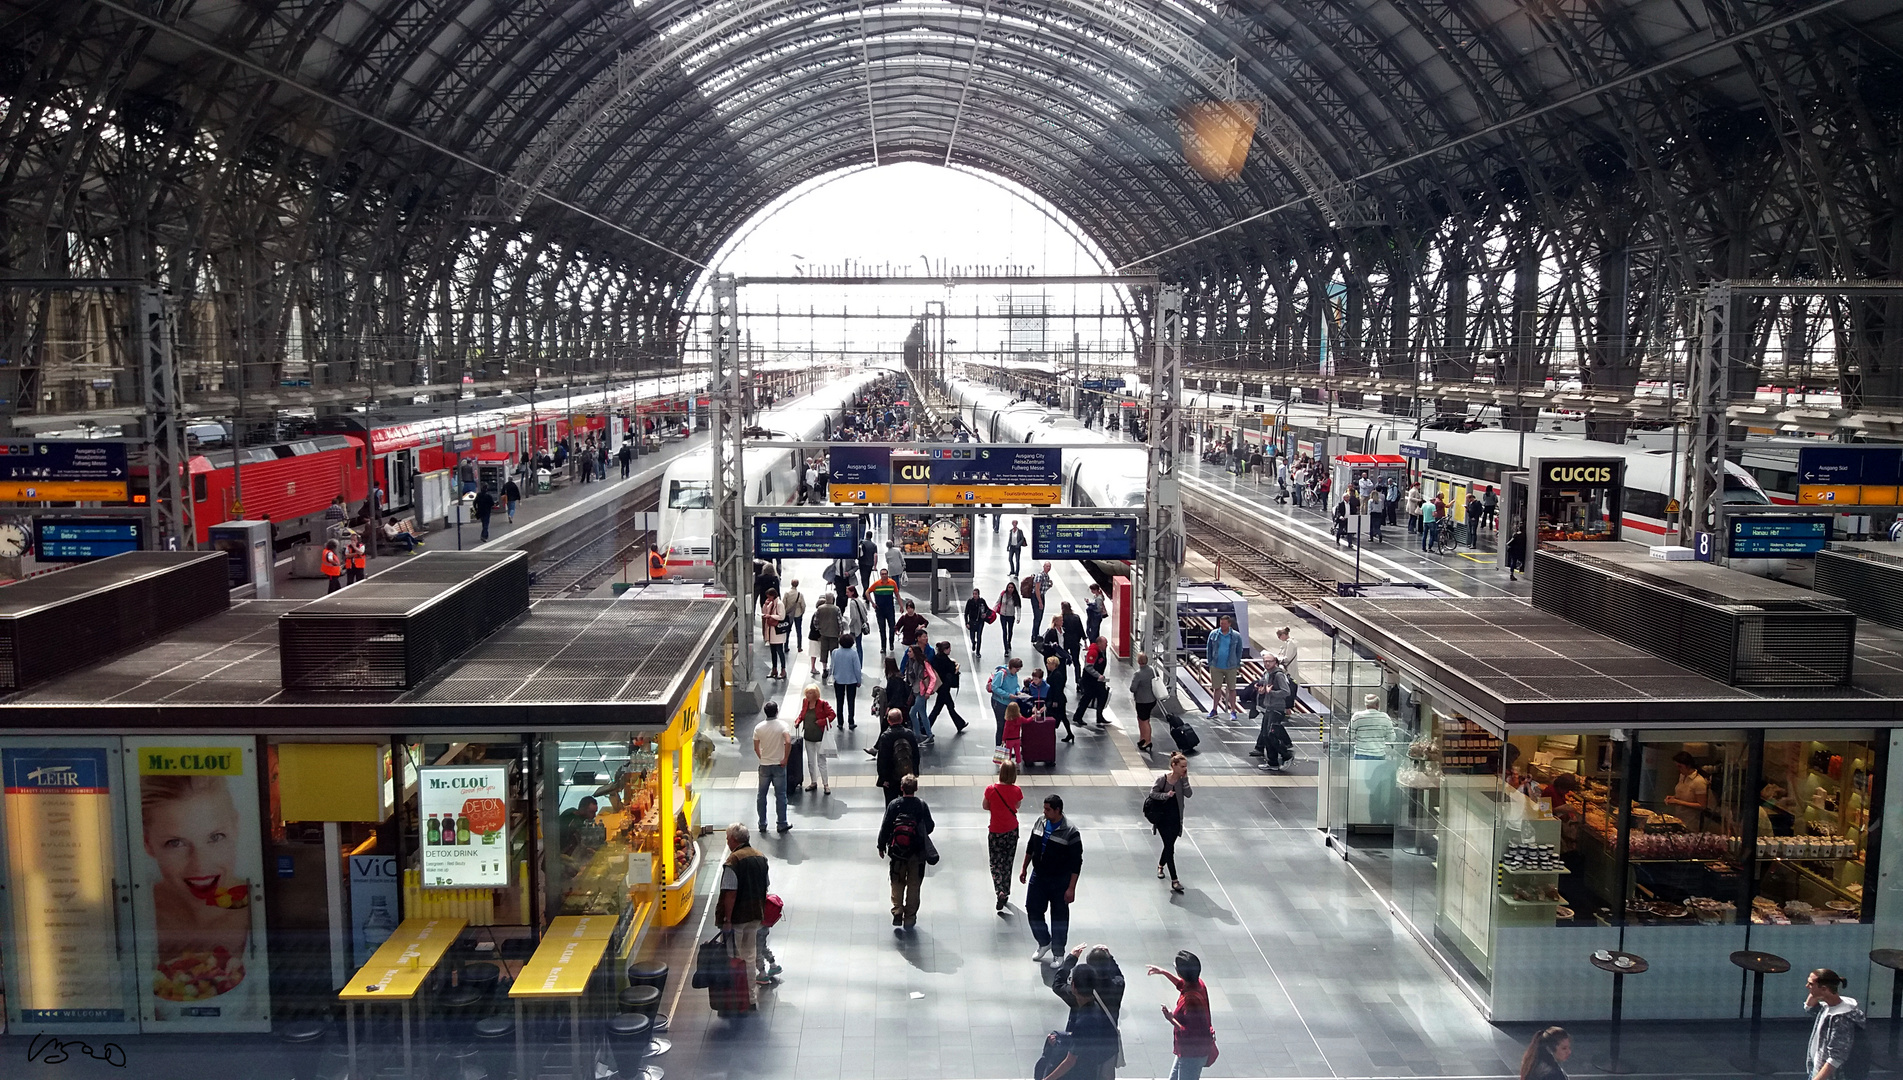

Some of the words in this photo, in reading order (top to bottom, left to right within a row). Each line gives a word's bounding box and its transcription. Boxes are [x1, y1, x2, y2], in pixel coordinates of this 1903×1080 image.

[40, 445, 48, 454] S
[934, 450, 941, 458] U
[982, 450, 990, 459] S
[1550, 467, 1611, 482] CUCCIS
[129, 525, 137, 536] 5
[761, 523, 768, 533] 6
[1123, 524, 1130, 535] 7
[1735, 523, 1742, 533] 8
[1700, 533, 1708, 555] 8
[148, 755, 177, 770] Mr.
[180, 755, 231, 770] CLOU
[37, 766, 79, 786] LEHR
[430, 778, 450, 789] Mr.
[452, 777, 488, 789] CLOU
[466, 798, 499, 814] DETOX
[454, 849, 478, 857] DRINK
